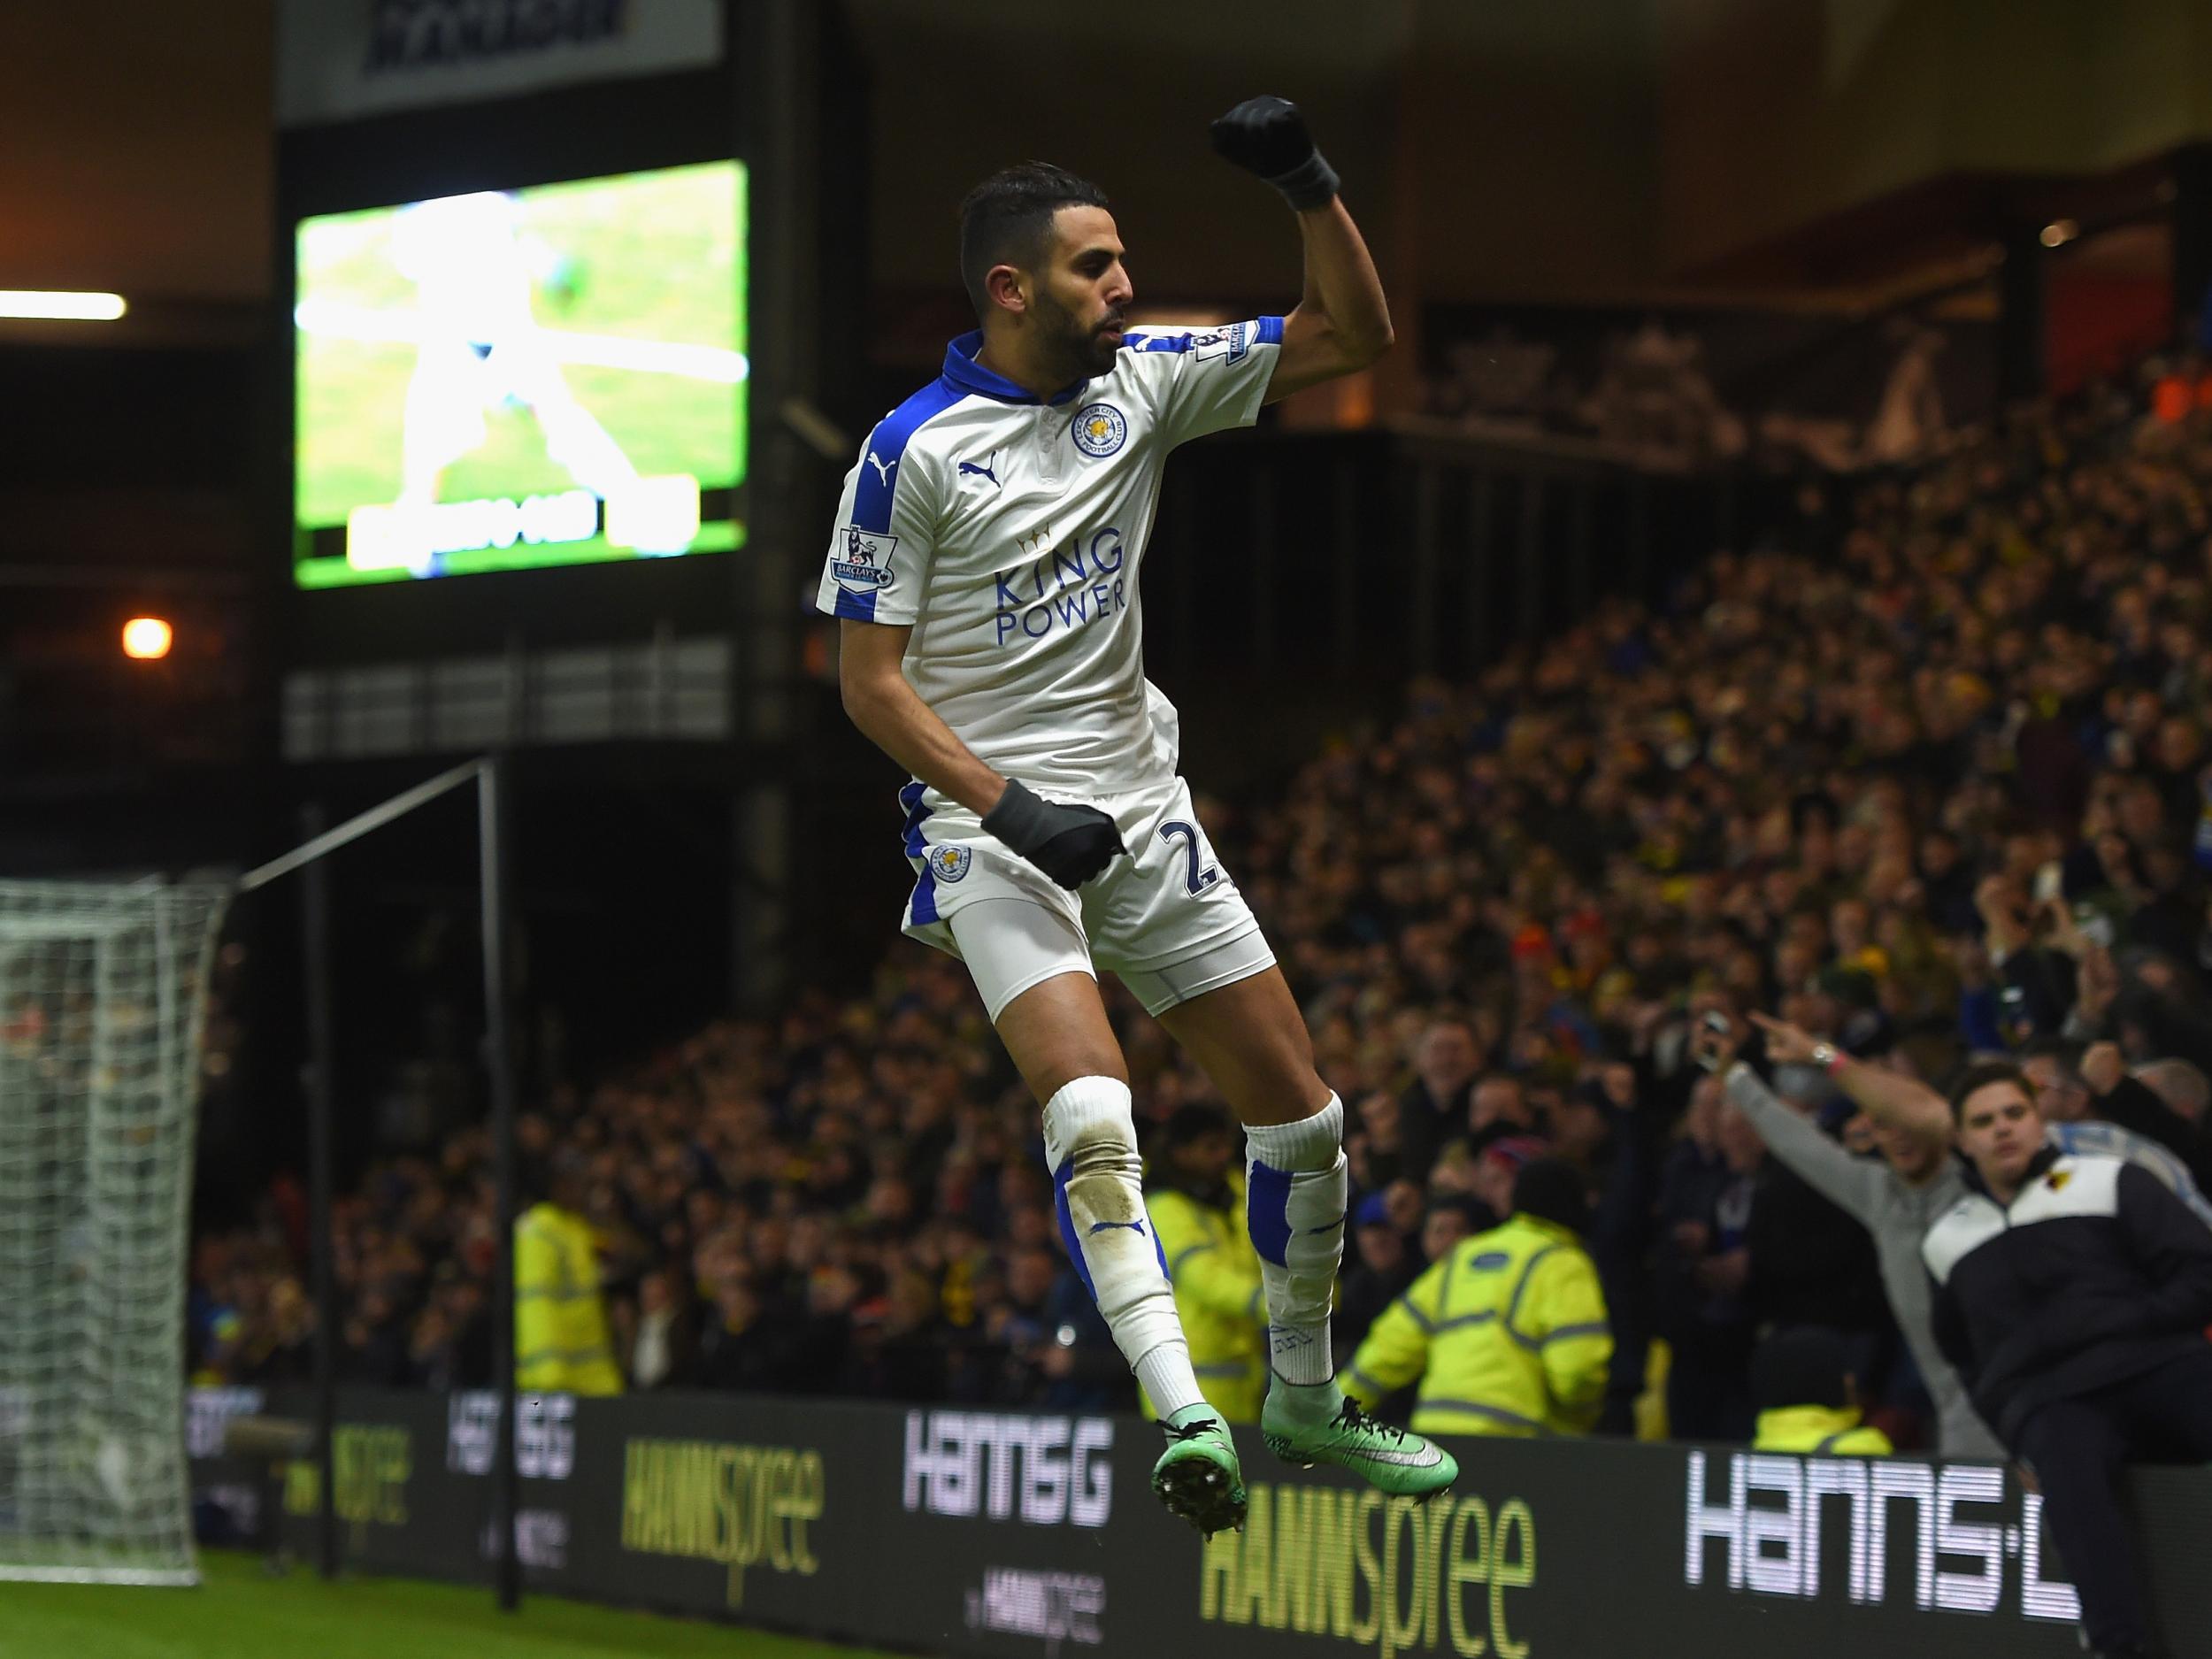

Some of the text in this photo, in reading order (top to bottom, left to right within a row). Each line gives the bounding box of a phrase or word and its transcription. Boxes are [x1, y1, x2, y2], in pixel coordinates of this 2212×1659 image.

[1077, 407, 1118, 440] LEICESTER CITY
[1082, 441, 1119, 453] FOOTBALL
[836, 564, 876, 577] BARCLAYS
[995, 527, 1123, 611] KING
[996, 579, 1125, 646] POWER
